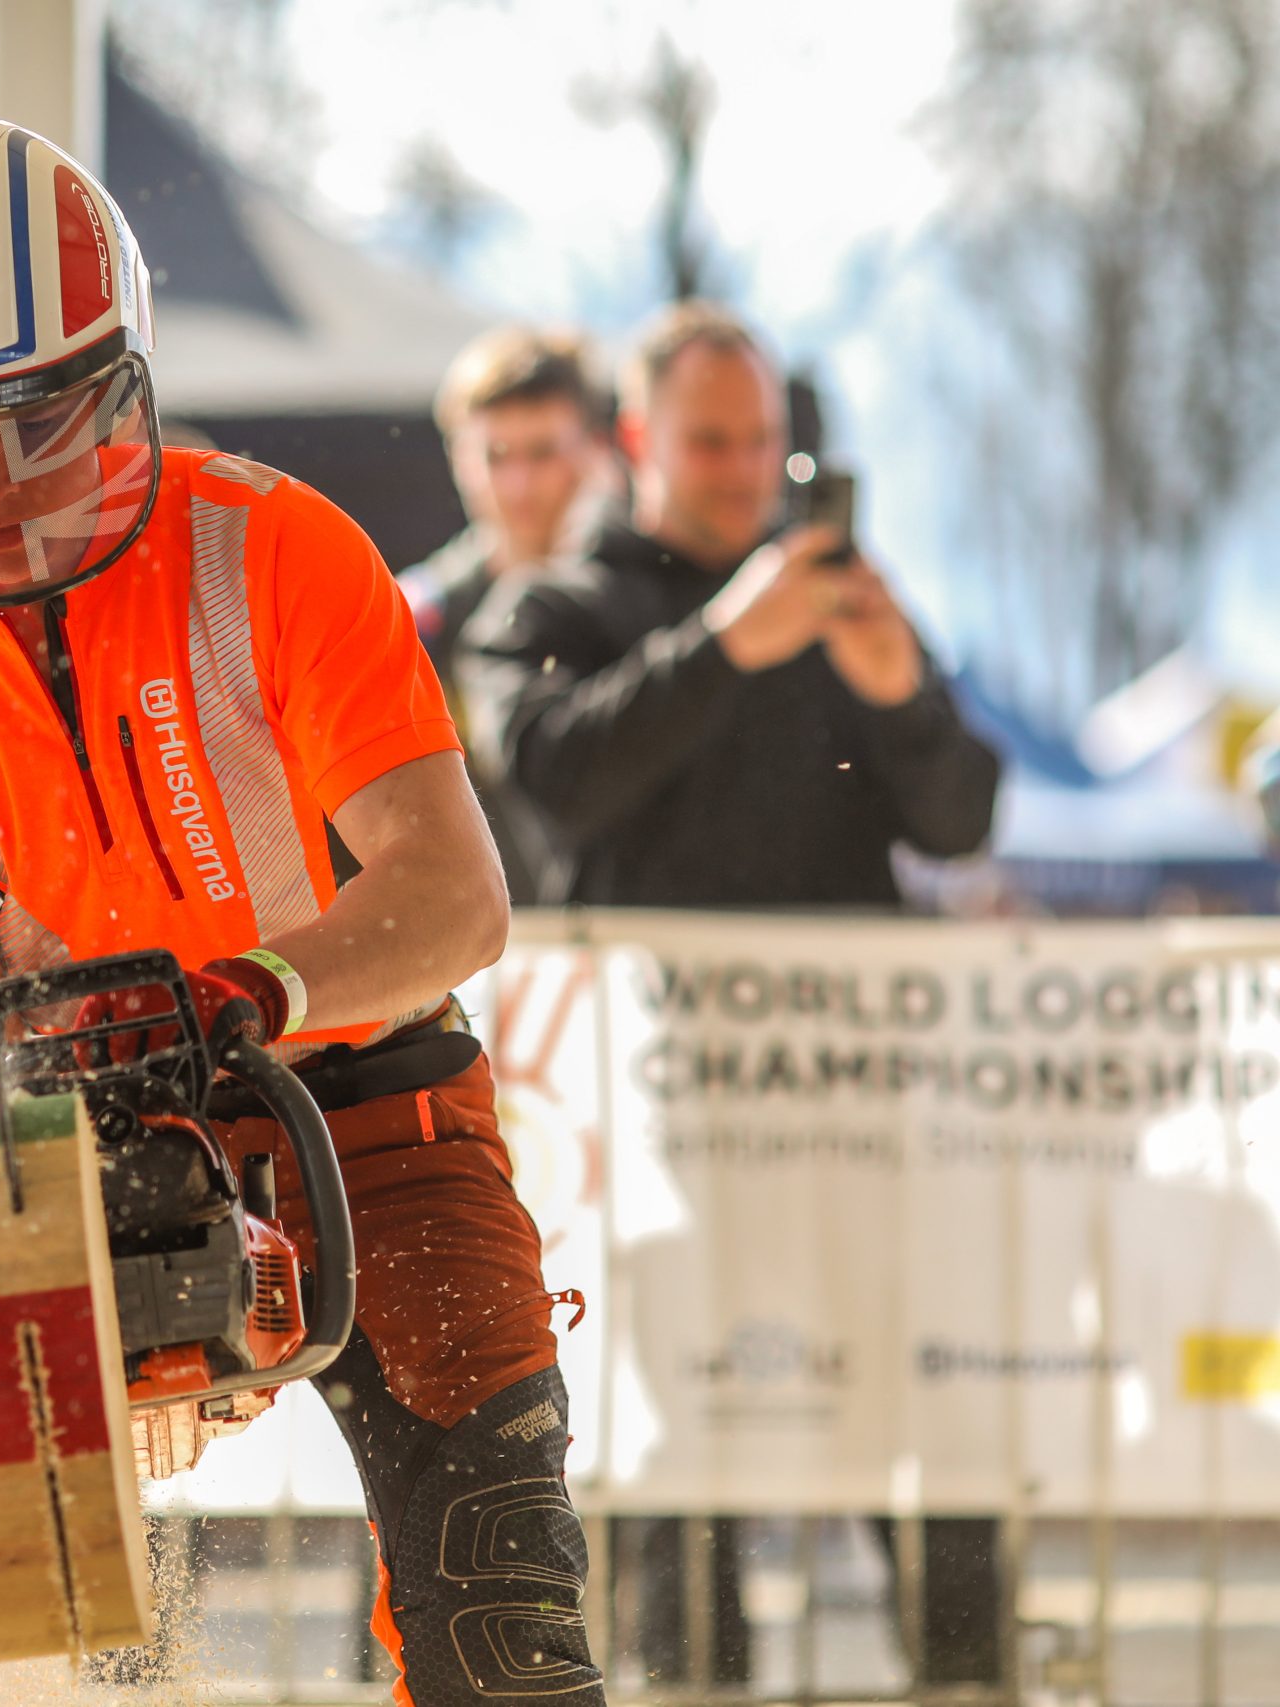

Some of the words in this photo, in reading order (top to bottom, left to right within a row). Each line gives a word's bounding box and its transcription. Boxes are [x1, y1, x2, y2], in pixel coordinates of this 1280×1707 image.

[81, 193, 110, 299] PROTOS
[154, 722, 235, 901] Husqvarna
[630, 960, 949, 1034] WORLD
[628, 1040, 1280, 1114] CHAMPIONSHIP
[496, 1398, 558, 1440] TECHNICAL
